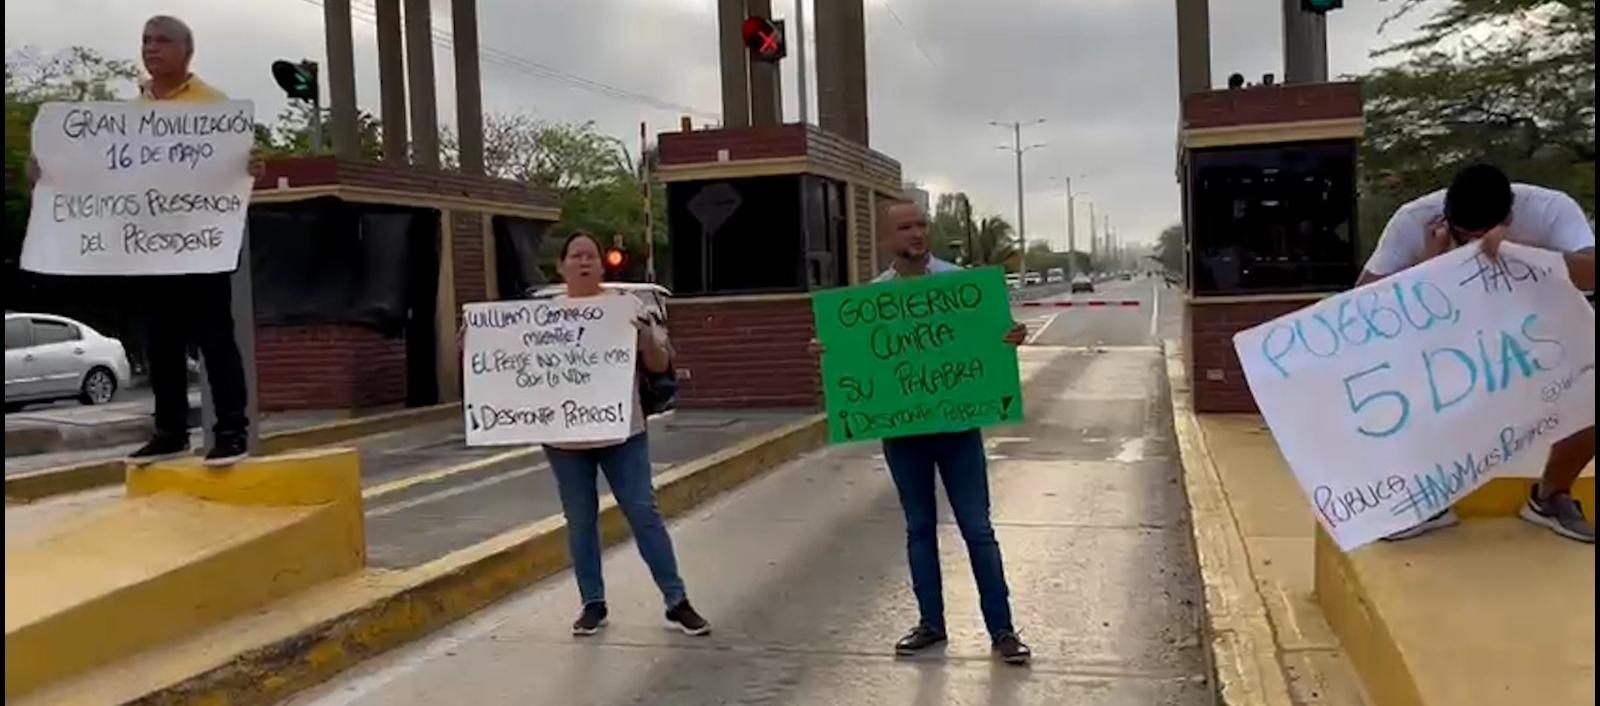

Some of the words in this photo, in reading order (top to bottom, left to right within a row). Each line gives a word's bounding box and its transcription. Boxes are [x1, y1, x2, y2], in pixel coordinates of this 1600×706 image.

[63, 109, 126, 138] GRAN
[139, 110, 256, 137] MOVILIZACIÓN
[107, 144, 133, 170] 16
[140, 145, 161, 165] DE
[169, 142, 214, 170] MAYO
[53, 194, 140, 222] EXIGIMOS
[146, 188, 241, 216] PRESENCIA
[81, 232, 105, 255] DEL
[123, 222, 224, 256] PRESIDENTE
[838, 283, 982, 328] GOBIERNO
[472, 351, 492, 375] EL
[537, 353, 560, 368] NO
[838, 376, 874, 402] SU
[895, 359, 984, 396] PALABRA
[1343, 361, 1410, 438] 5
